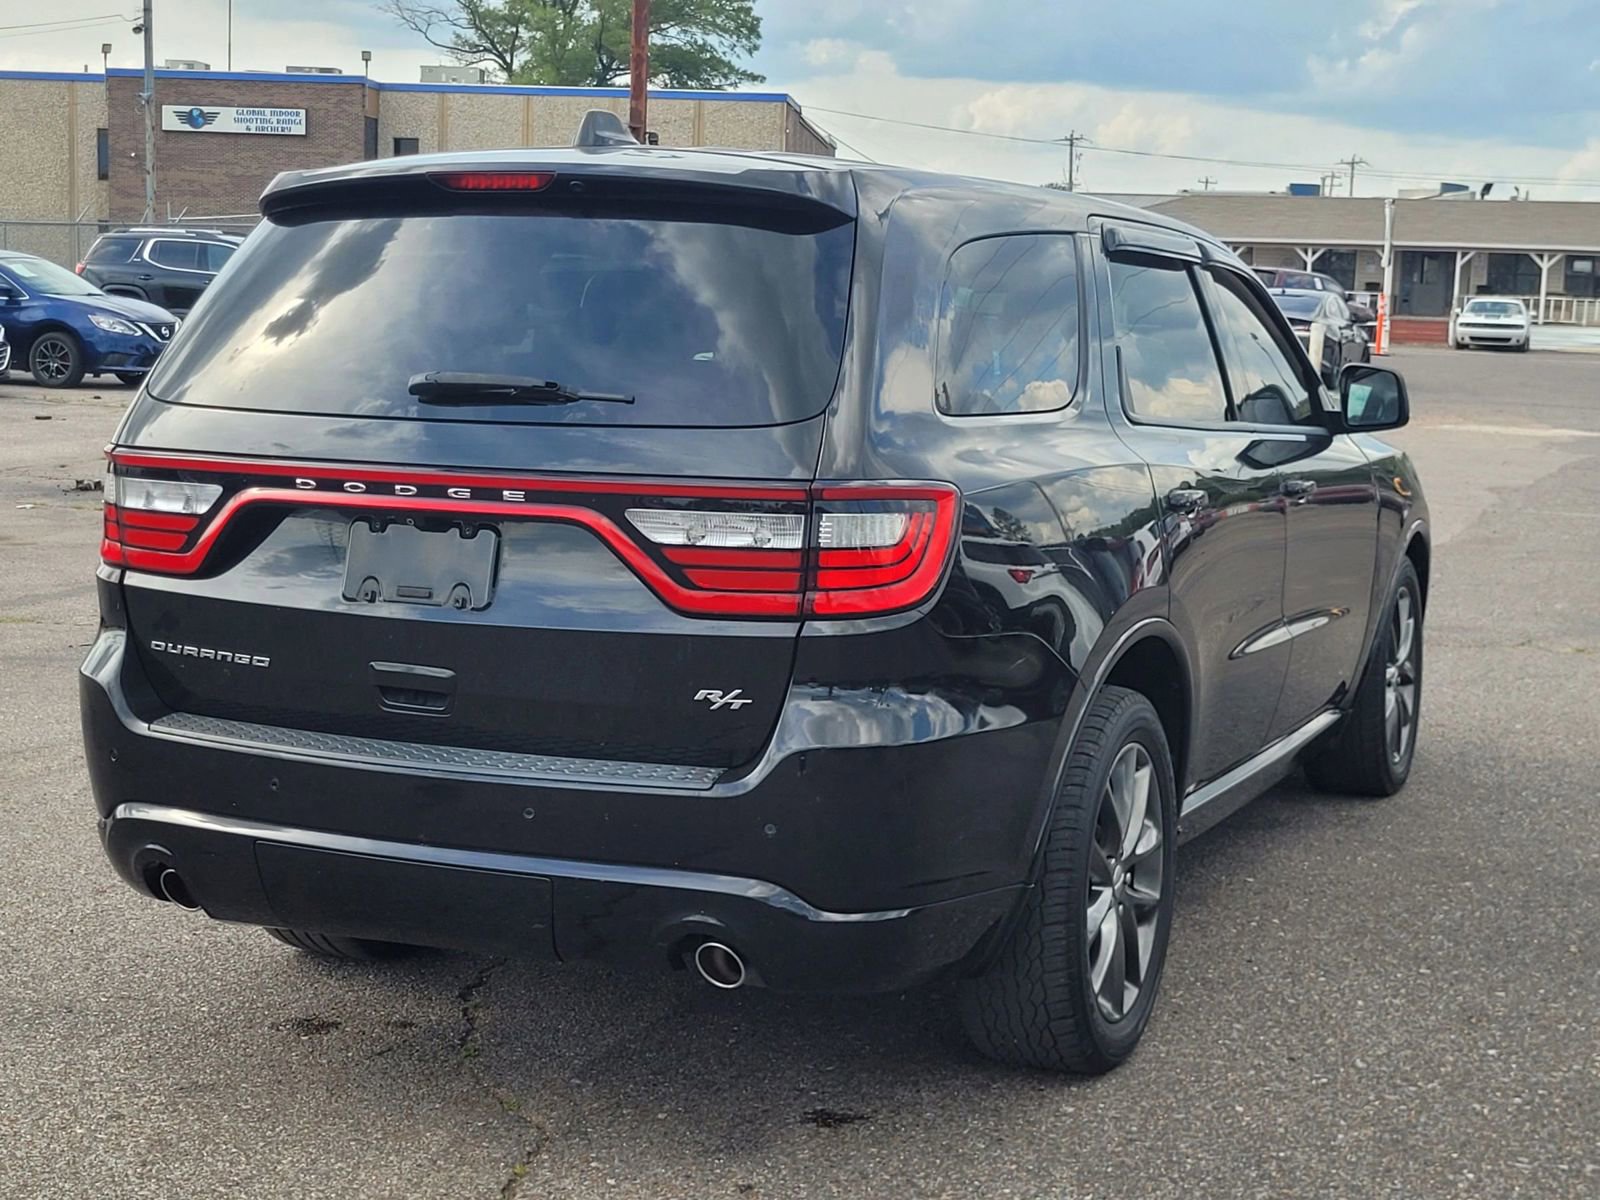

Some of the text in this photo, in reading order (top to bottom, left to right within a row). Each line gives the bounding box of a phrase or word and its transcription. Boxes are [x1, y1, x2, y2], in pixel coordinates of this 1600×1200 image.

[233, 116, 274, 125] SHOOTING
[295, 477, 526, 502] DODGE
[150, 640, 271, 668] DURANGO
[693, 689, 753, 710] R/T
